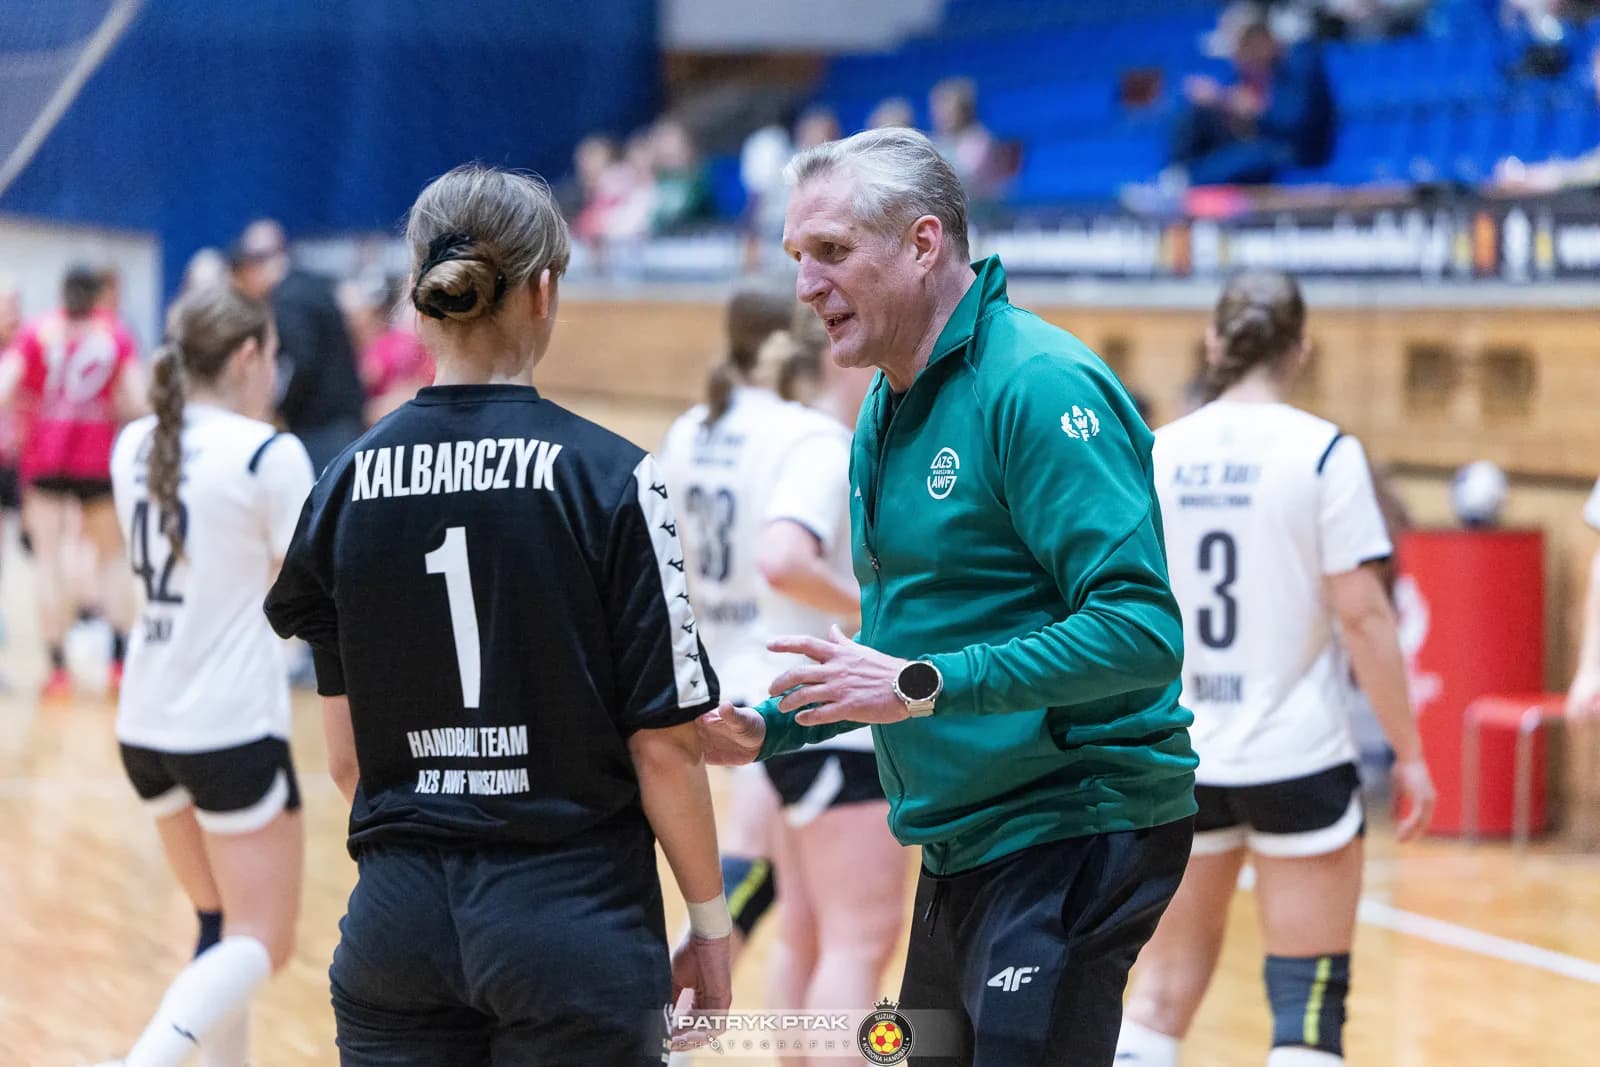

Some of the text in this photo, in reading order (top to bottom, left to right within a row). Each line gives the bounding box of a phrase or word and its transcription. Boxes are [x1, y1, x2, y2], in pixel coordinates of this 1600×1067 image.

[352, 438, 562, 501] KALBARCZYK
[936, 456, 953, 469] AZS
[931, 476, 951, 488] AWF
[131, 501, 188, 603] 42
[1197, 530, 1237, 649] 3
[424, 526, 482, 709] 1
[480, 725, 528, 757] TEAM
[415, 769, 440, 794] AZS
[441, 769, 467, 794] AWF
[987, 966, 1034, 992] 4F
